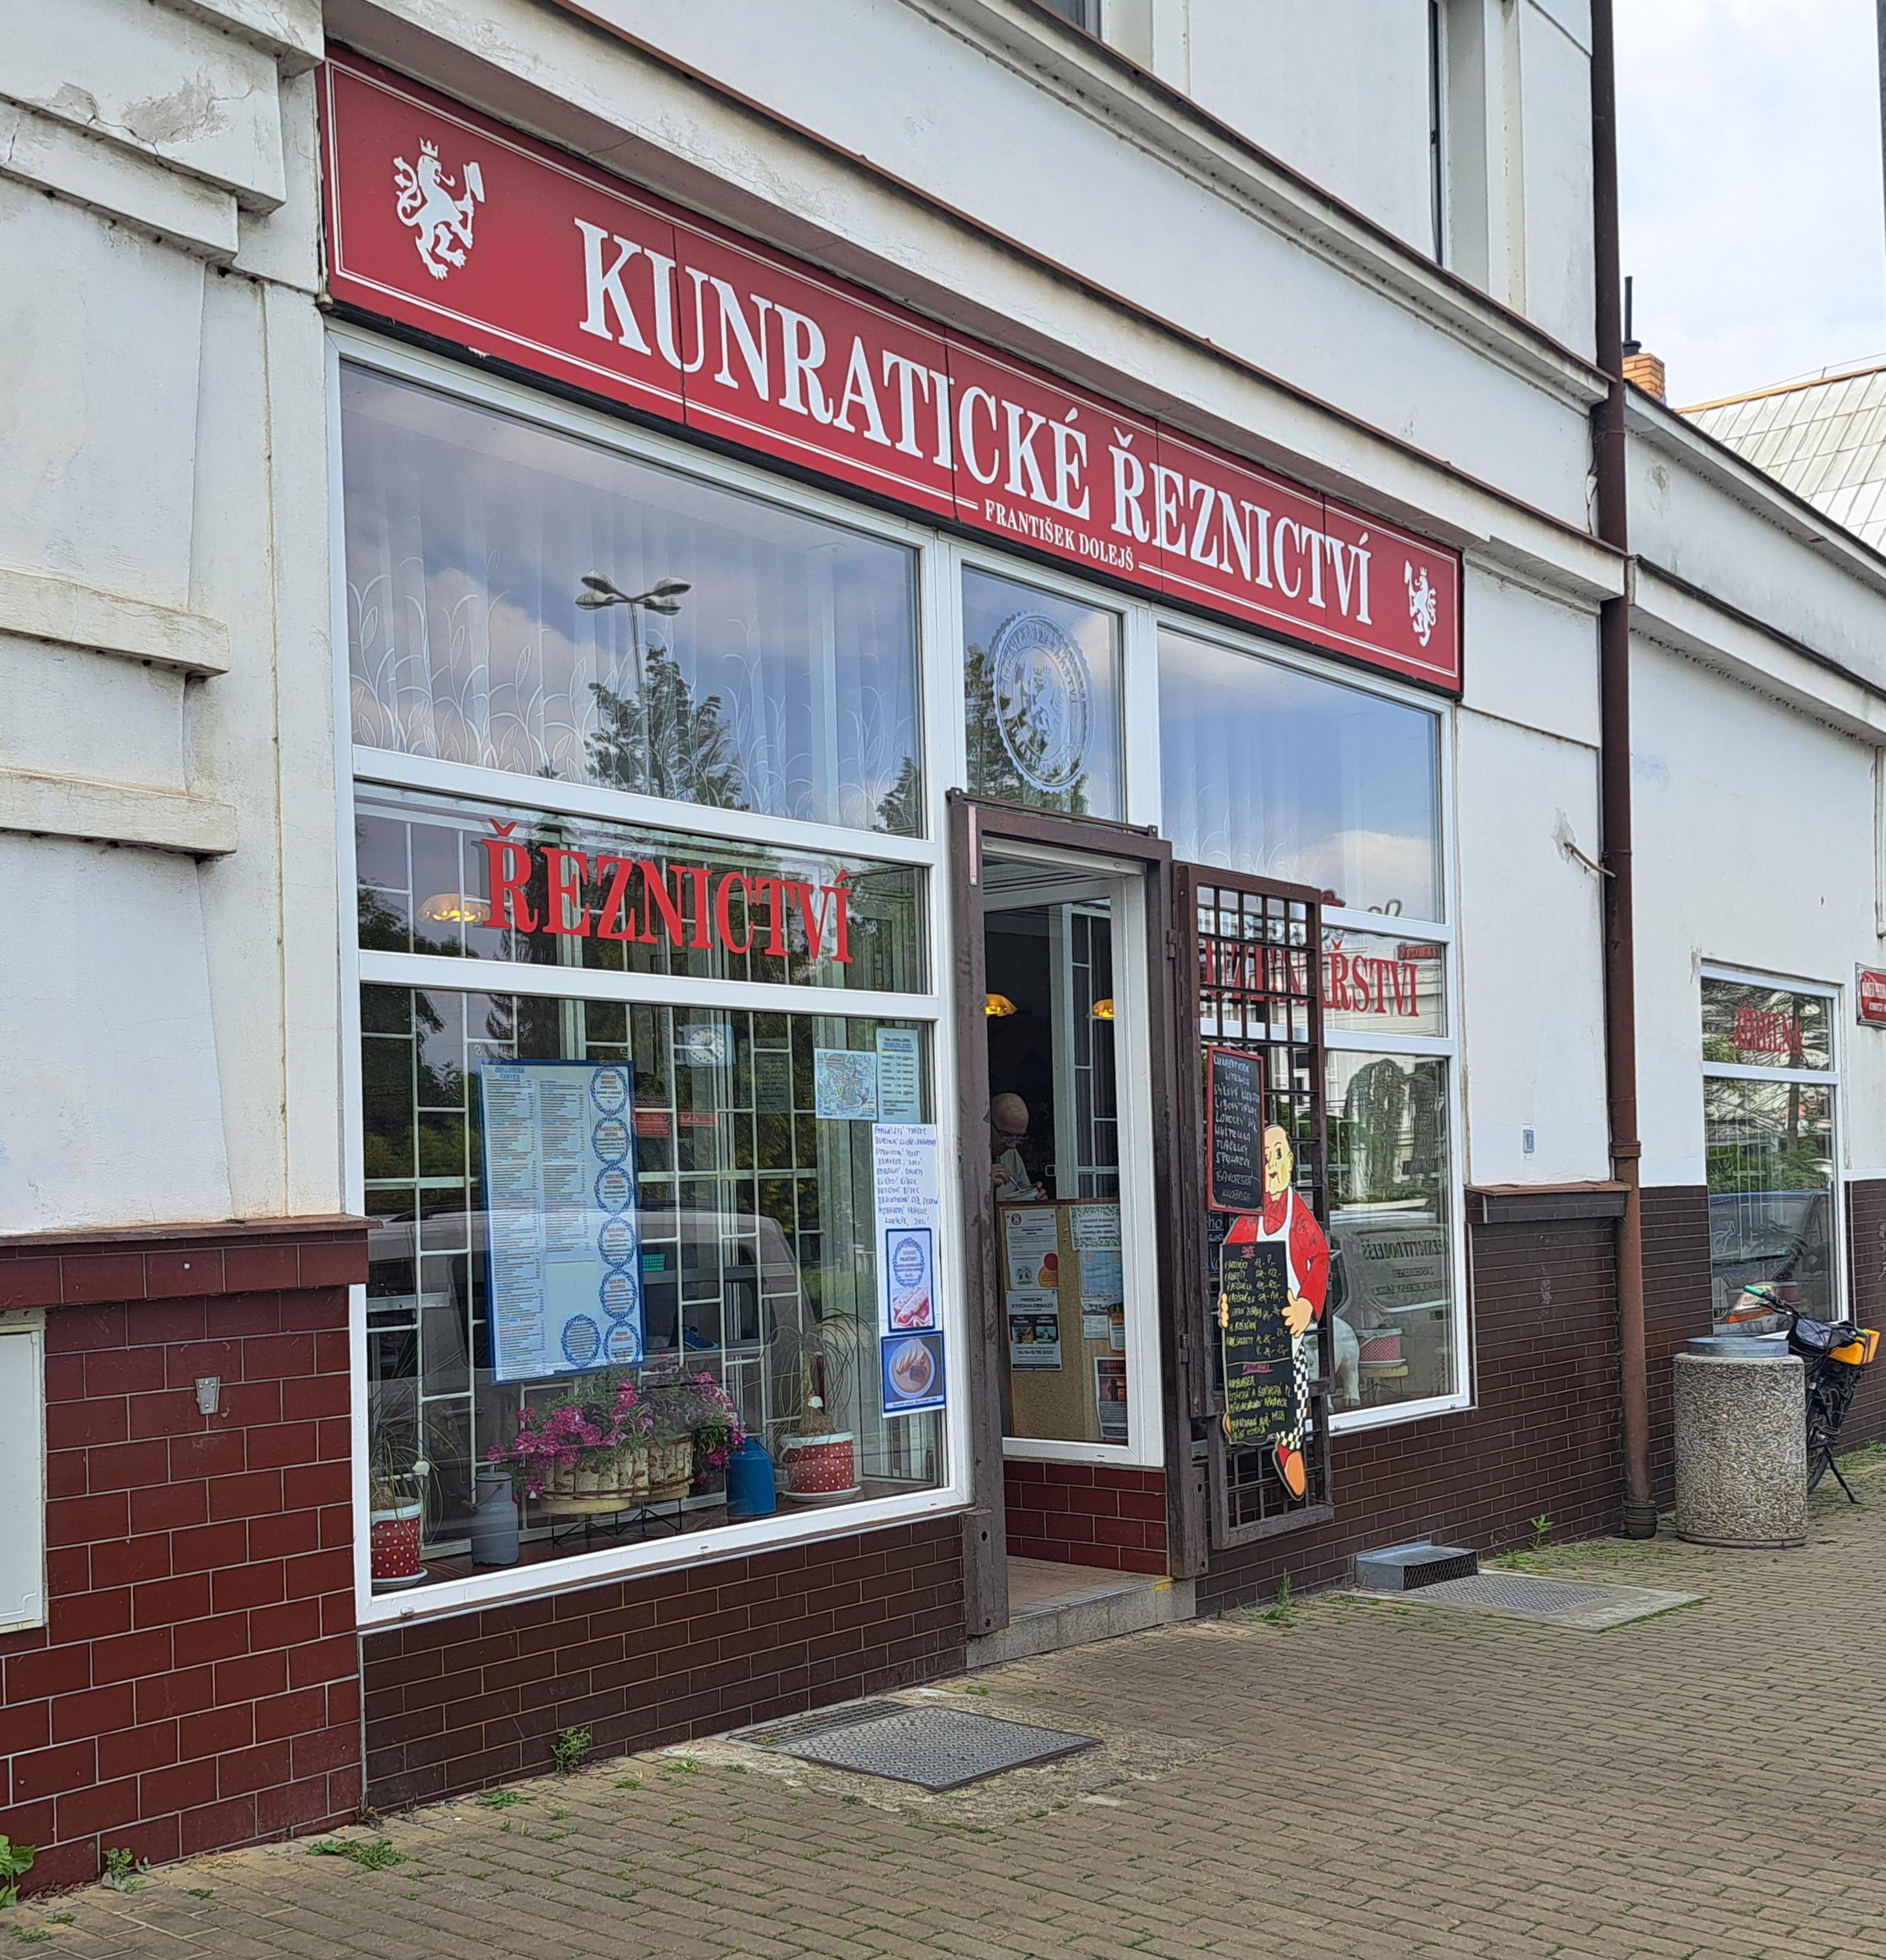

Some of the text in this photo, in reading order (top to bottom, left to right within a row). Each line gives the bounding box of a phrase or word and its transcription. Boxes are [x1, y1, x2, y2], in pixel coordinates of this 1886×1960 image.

[574, 218, 1373, 625] KUNRATICKÉ ŘEZNICTVÍ
[984, 498, 1134, 572] FRANTIŠEK DOLEJŠ
[482, 817, 854, 964] ŘEZNICTVÍ
